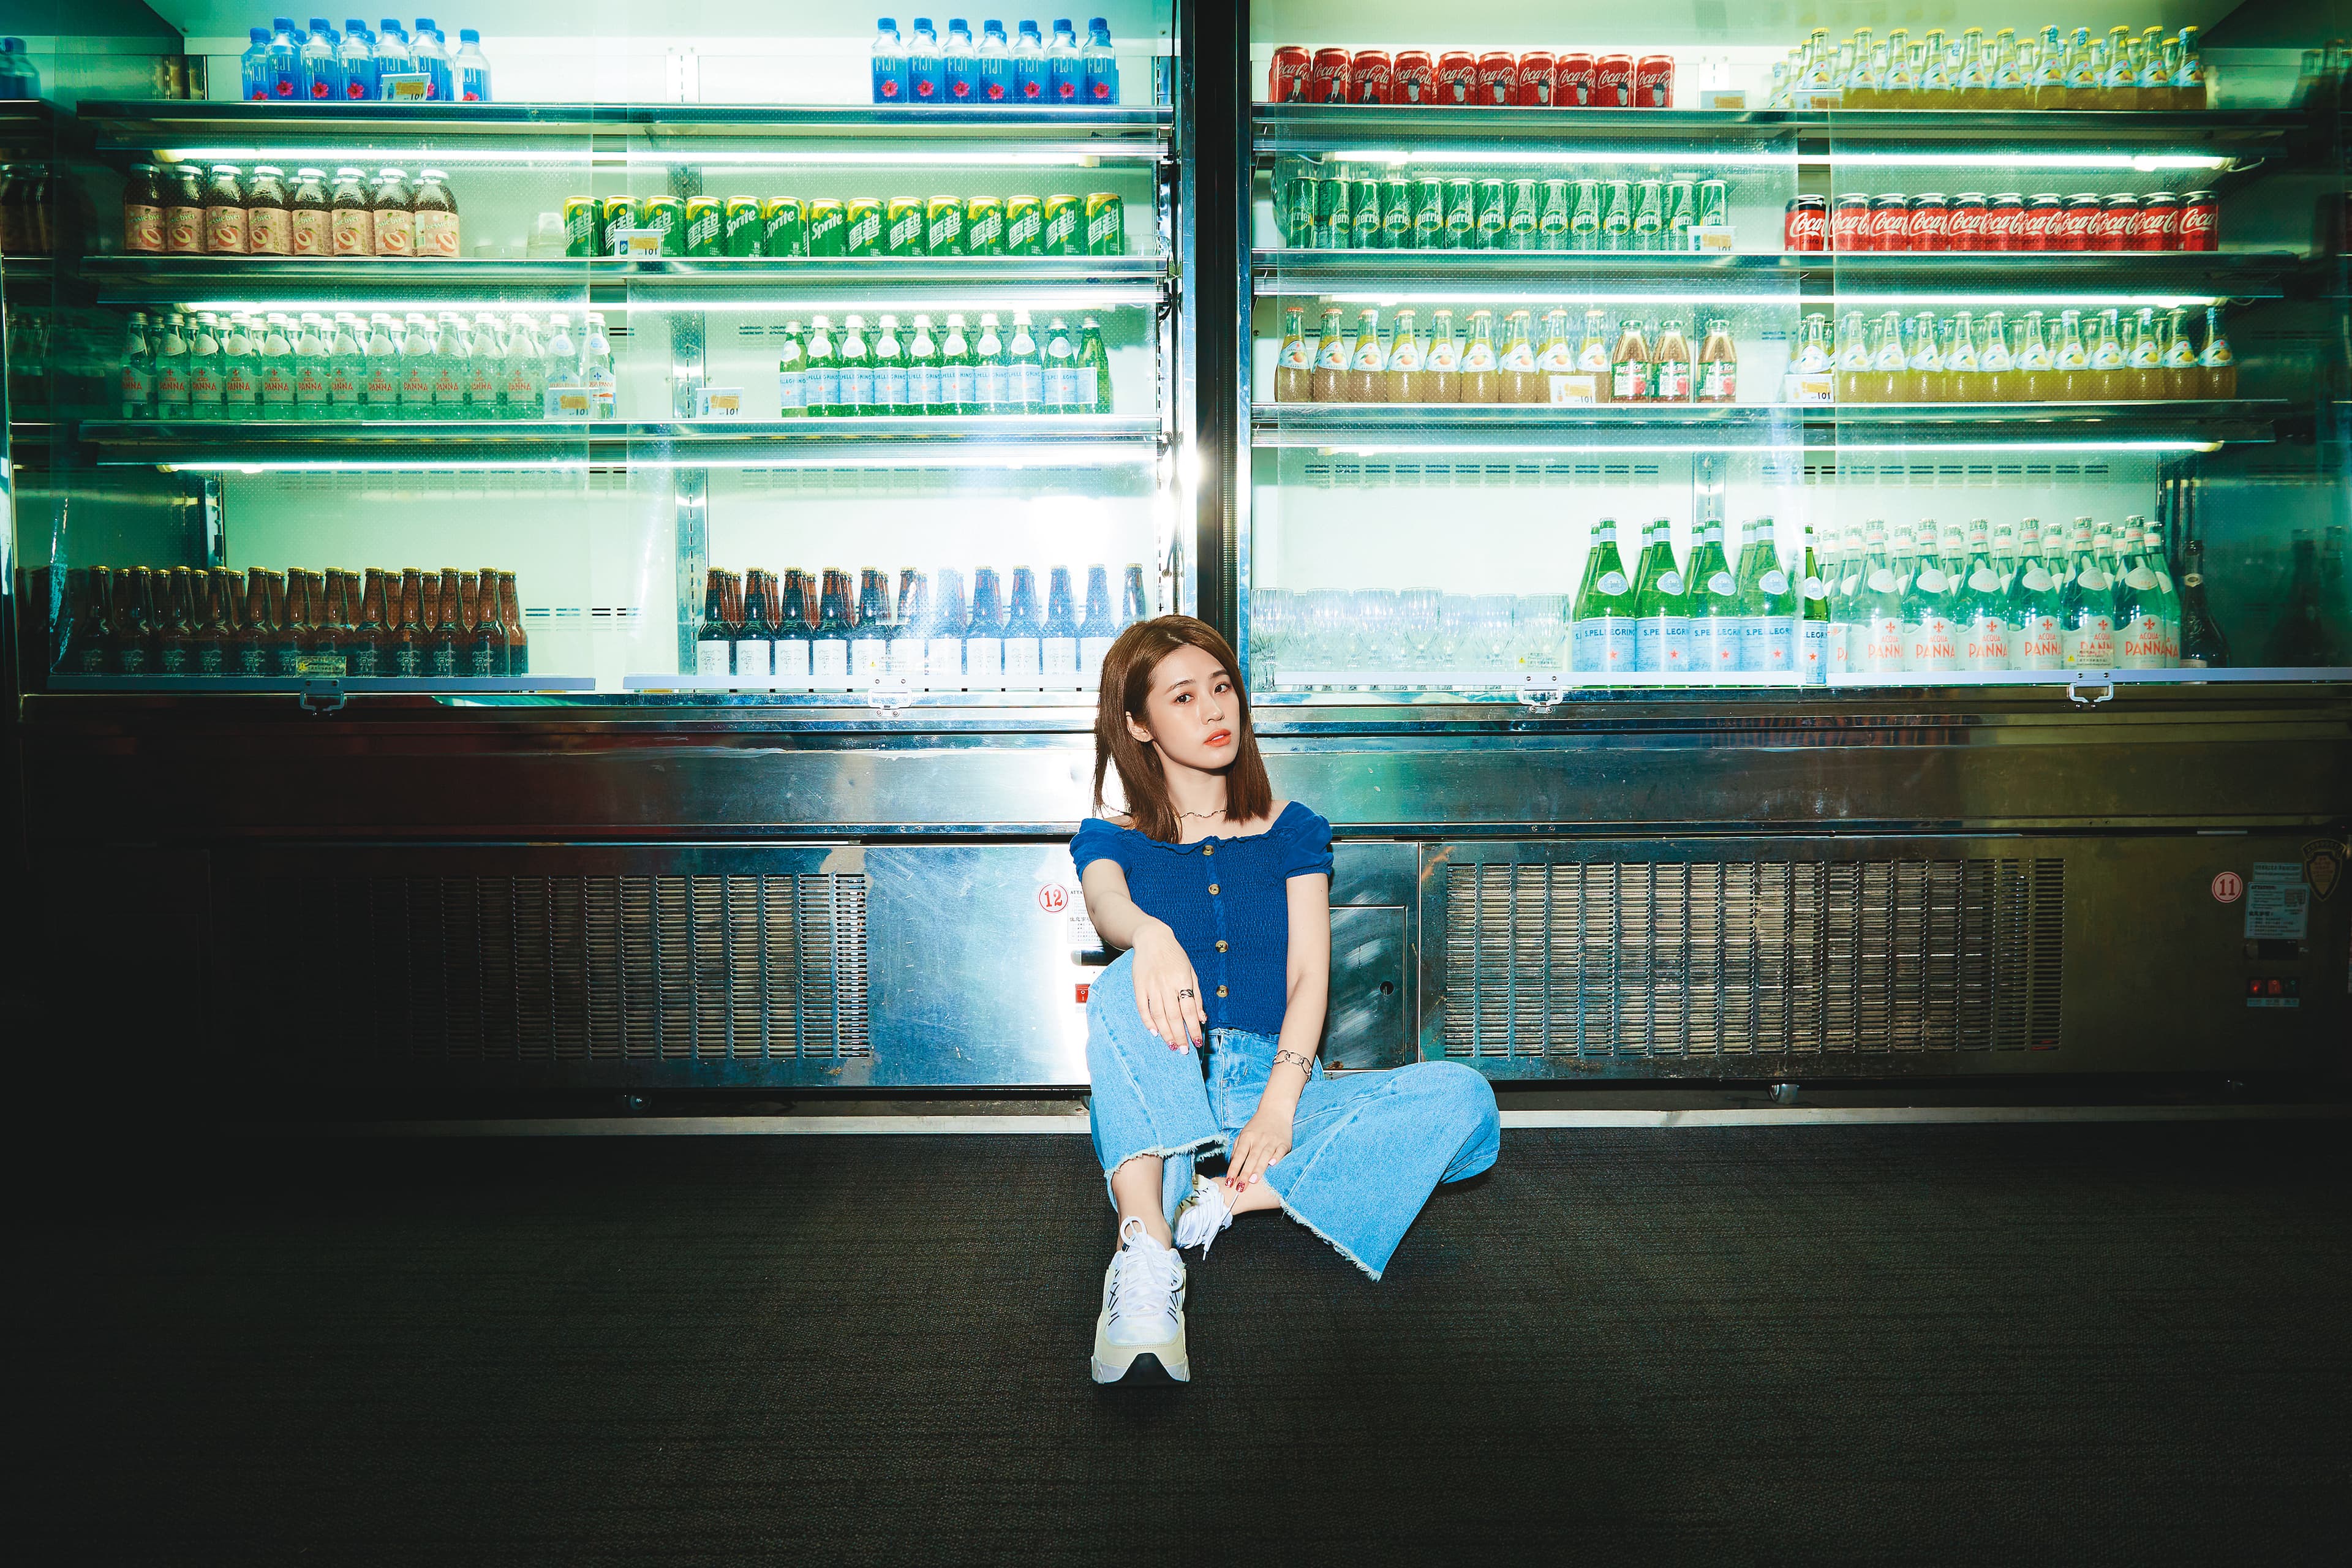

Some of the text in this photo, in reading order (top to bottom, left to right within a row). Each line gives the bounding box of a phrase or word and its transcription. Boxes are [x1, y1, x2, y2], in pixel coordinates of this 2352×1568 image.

[875, 55, 896, 72] FIJI
[912, 55, 933, 71] FIJI
[948, 55, 968, 72] FIJI
[982, 58, 1003, 75] FIJI
[1019, 57, 1039, 73] FIJI
[1053, 57, 1073, 73] FIJI
[1087, 57, 1107, 73] FIJI
[687, 211, 722, 251] 雪碧
[726, 209, 756, 238] Sprite
[766, 209, 795, 239] Sprite
[812, 213, 843, 241] Sprite
[890, 212, 923, 251] 雪碧
[929, 211, 962, 250] 雪碧
[970, 212, 1003, 251] 雪碧
[1009, 210, 1042, 251] 雪碧
[1046, 209, 1077, 250] 雪碧
[1087, 207, 1120, 247] 雪碧
[849, 213, 882, 252] 雪碧
[159, 381, 185, 391] PANNA
[192, 381, 217, 391] PANNA
[227, 382, 251, 391] PANNA
[265, 382, 289, 391] PANNA
[298, 382, 323, 391] PANNA
[331, 382, 353, 391] PANNA
[368, 382, 393, 392] PANNA
[404, 382, 429, 391] PANNA
[436, 382, 459, 391] PANNA
[470, 382, 492, 391] PANNA
[508, 382, 532, 391] PANNA
[1916, 643, 1956, 659] PANNA
[1969, 643, 2008, 658] PANNA
[2125, 641, 2166, 656] PANNA
[2219, 878, 2236, 896] 11
[1044, 889, 1063, 908] 12
